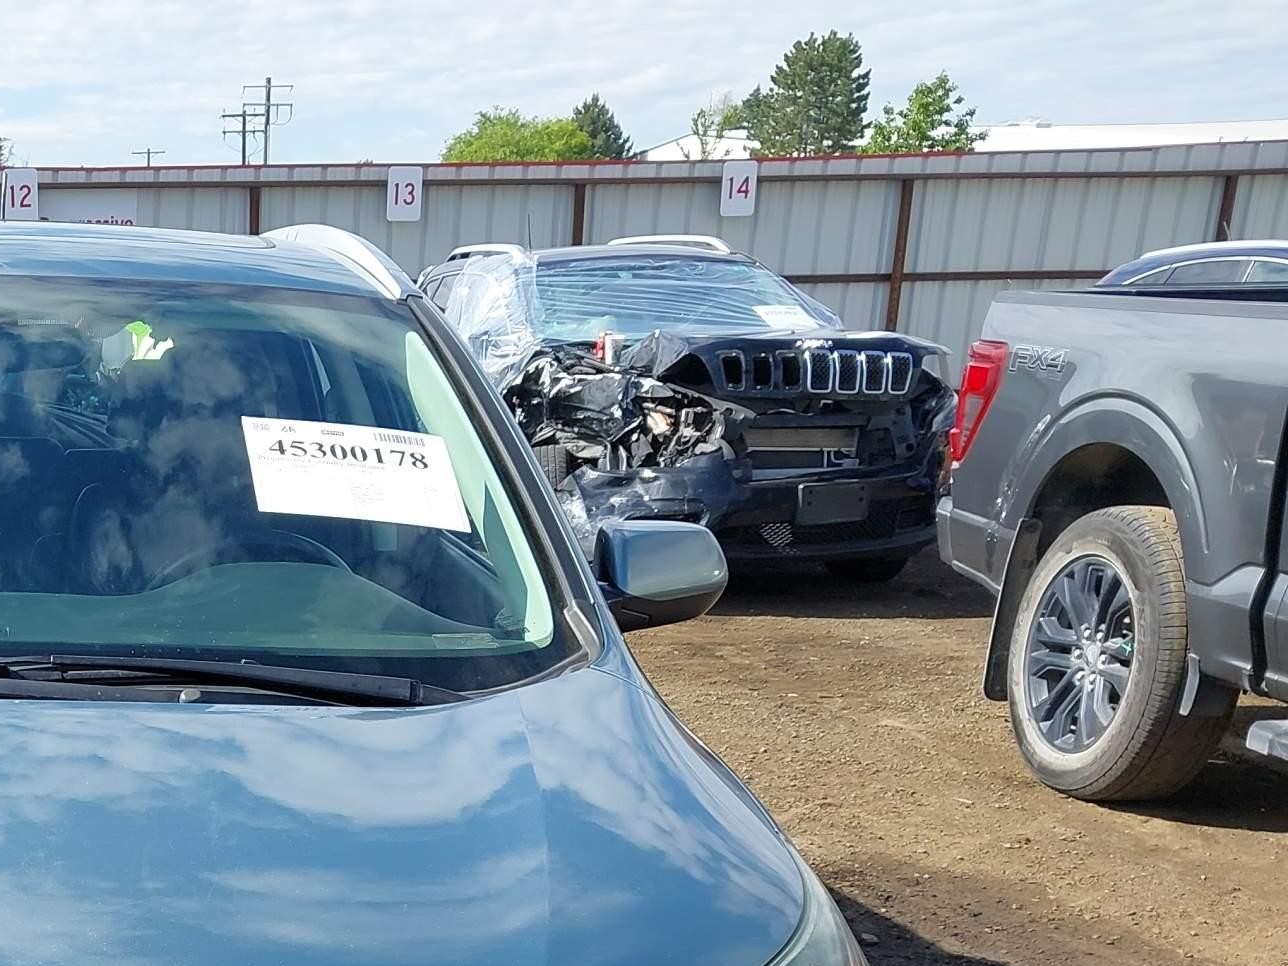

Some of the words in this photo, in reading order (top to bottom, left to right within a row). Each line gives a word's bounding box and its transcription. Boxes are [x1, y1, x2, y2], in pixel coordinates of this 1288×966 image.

[9, 184, 32, 209] 12
[394, 182, 416, 206] 13
[728, 175, 750, 200] 14
[1008, 344, 1069, 374] FX4
[268, 438, 429, 470] 45300178
